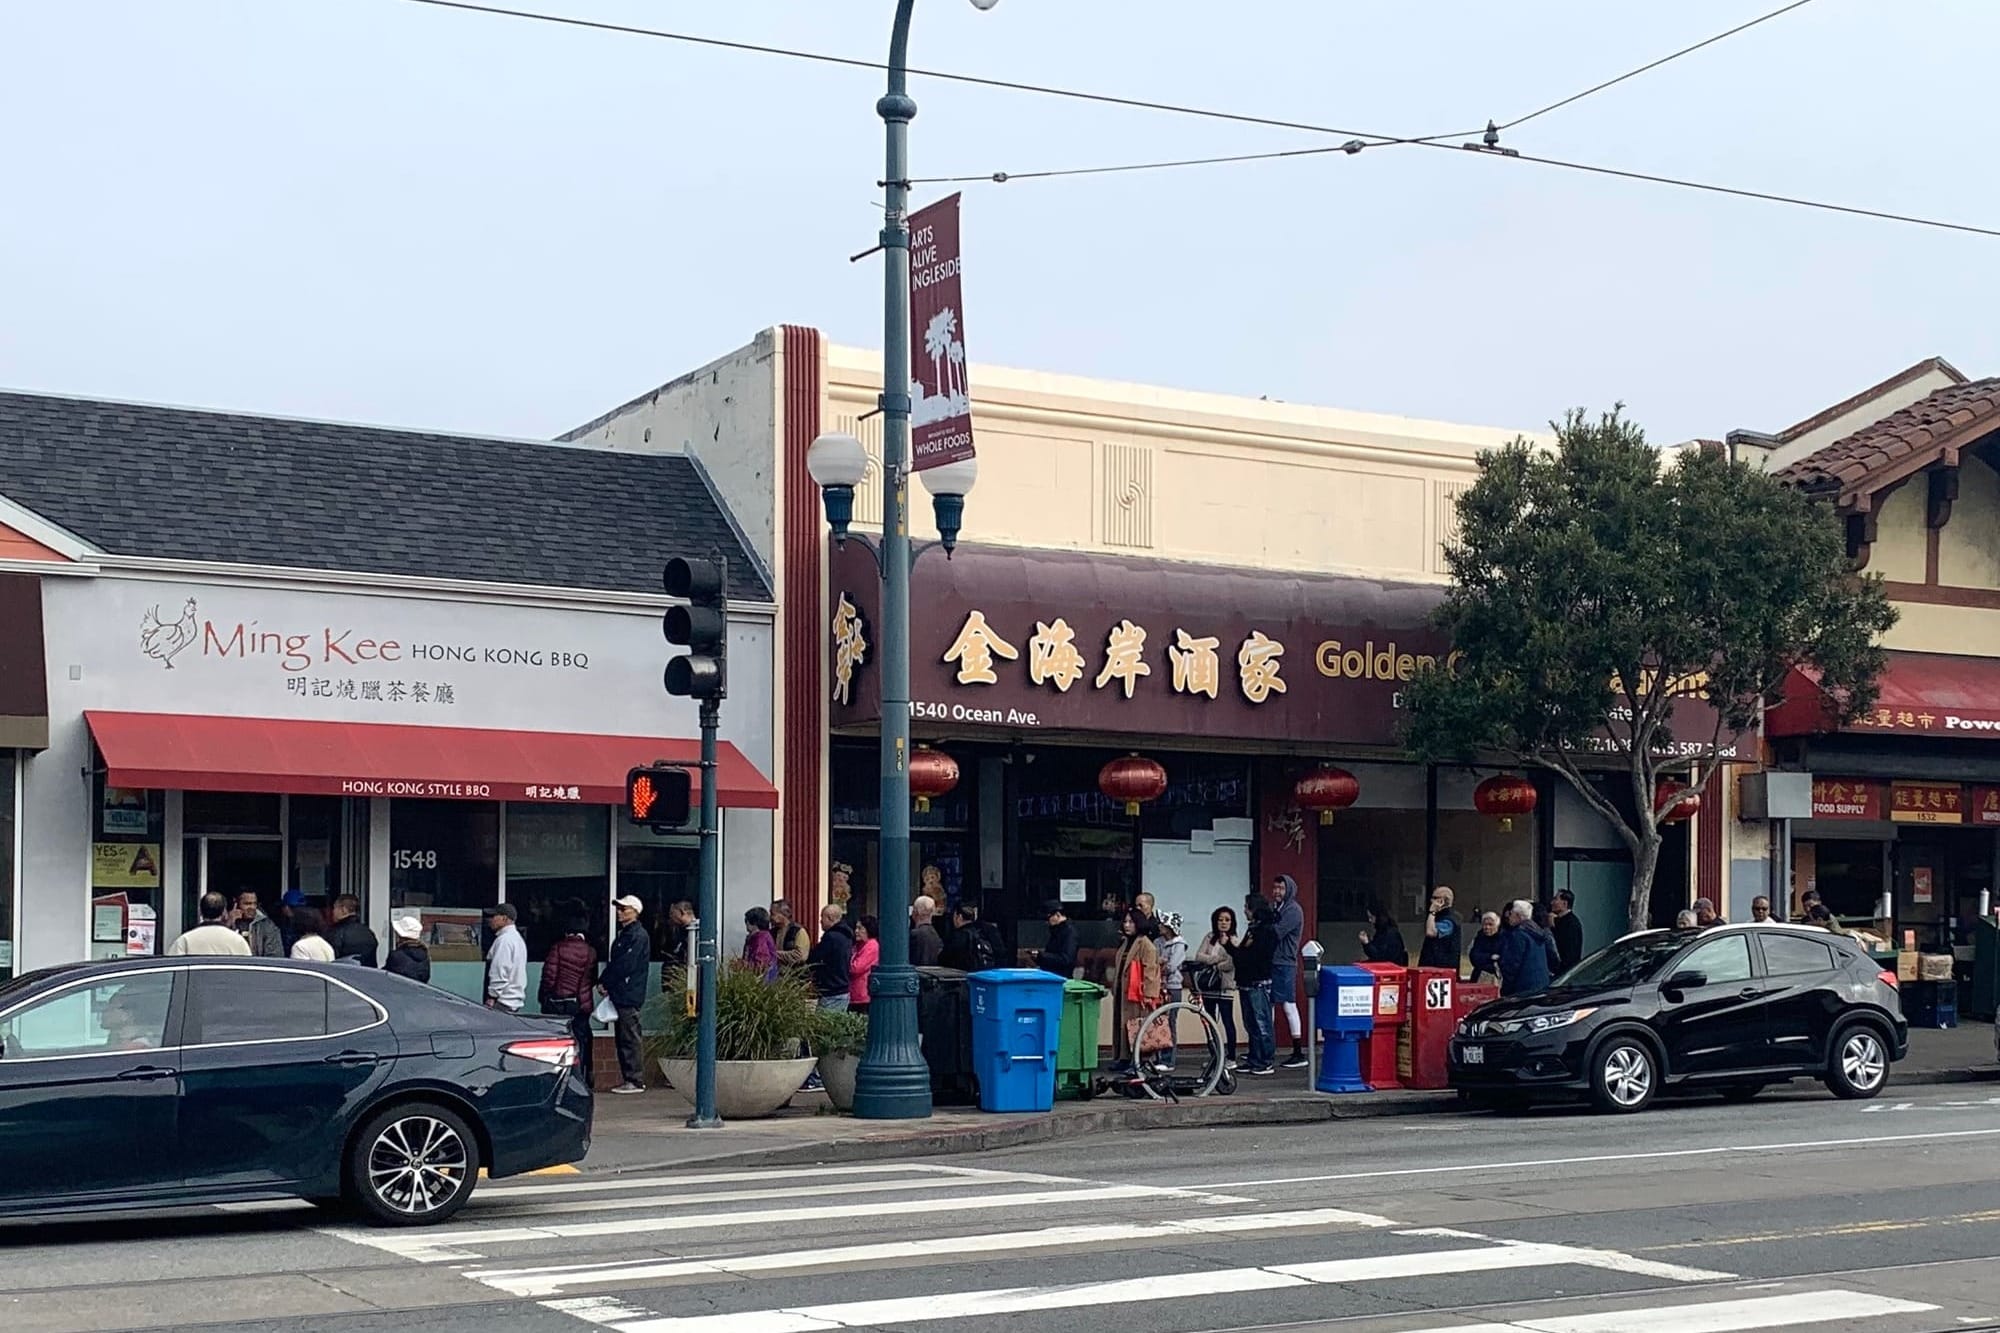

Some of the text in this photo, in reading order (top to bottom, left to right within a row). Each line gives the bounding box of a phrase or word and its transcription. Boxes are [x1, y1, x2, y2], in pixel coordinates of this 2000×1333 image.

[910, 225, 934, 250] ARTS
[911, 245, 937, 272] ALIVE
[912, 257, 961, 292] INGLESIDE
[915, 439, 943, 456] WHOLE
[943, 431, 971, 449] FOODS
[203, 620, 402, 672] Ming Kee
[412, 644, 589, 669] HONG KONG BBQ
[944, 610, 1288, 704] 金海岸酒家
[1315, 640, 1436, 682] Golden
[286, 676, 455, 705] 明記燒臘茶餐廳
[907, 701, 1041, 726] 1540 Ocean Ave.
[342, 780, 490, 798] HONG KONG STYLE BBQ
[1814, 802, 1866, 815] FOOD SUPPLY
[1917, 812, 1937, 822] 1532
[392, 849, 438, 870] 1548
[1427, 979, 1450, 1009] SF
